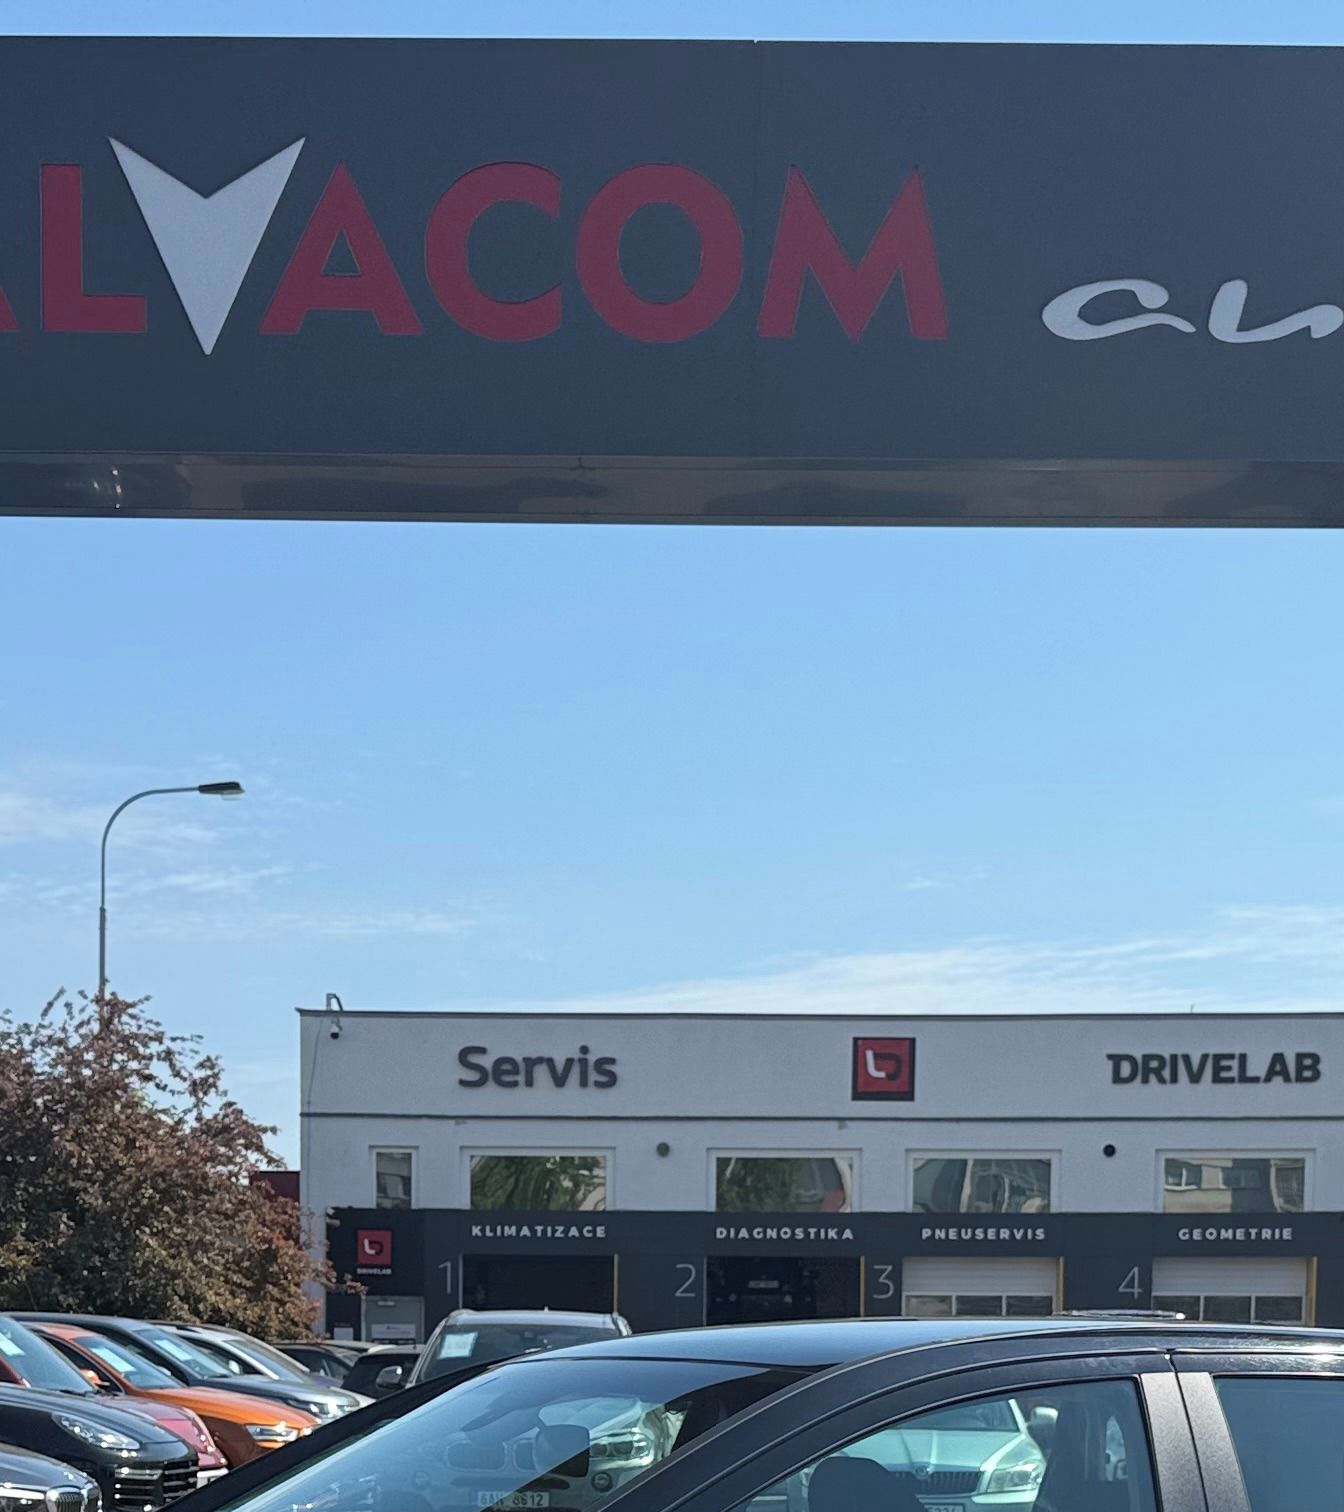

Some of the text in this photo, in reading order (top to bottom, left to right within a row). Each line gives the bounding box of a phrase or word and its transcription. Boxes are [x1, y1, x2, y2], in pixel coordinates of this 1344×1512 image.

[457, 1044, 618, 1088] Servis
[1106, 1052, 1322, 1085] DRIVELAB
[471, 1225, 607, 1239] KLIMATIZACE
[715, 1226, 854, 1240] DIAGNOSTIKA
[921, 1227, 1046, 1241] PNEUSERVIS
[1178, 1227, 1294, 1241] GEOMETRIE
[438, 1261, 452, 1294] 1
[674, 1263, 697, 1297] 2
[872, 1265, 895, 1299] 3
[1118, 1266, 1144, 1300] 4
